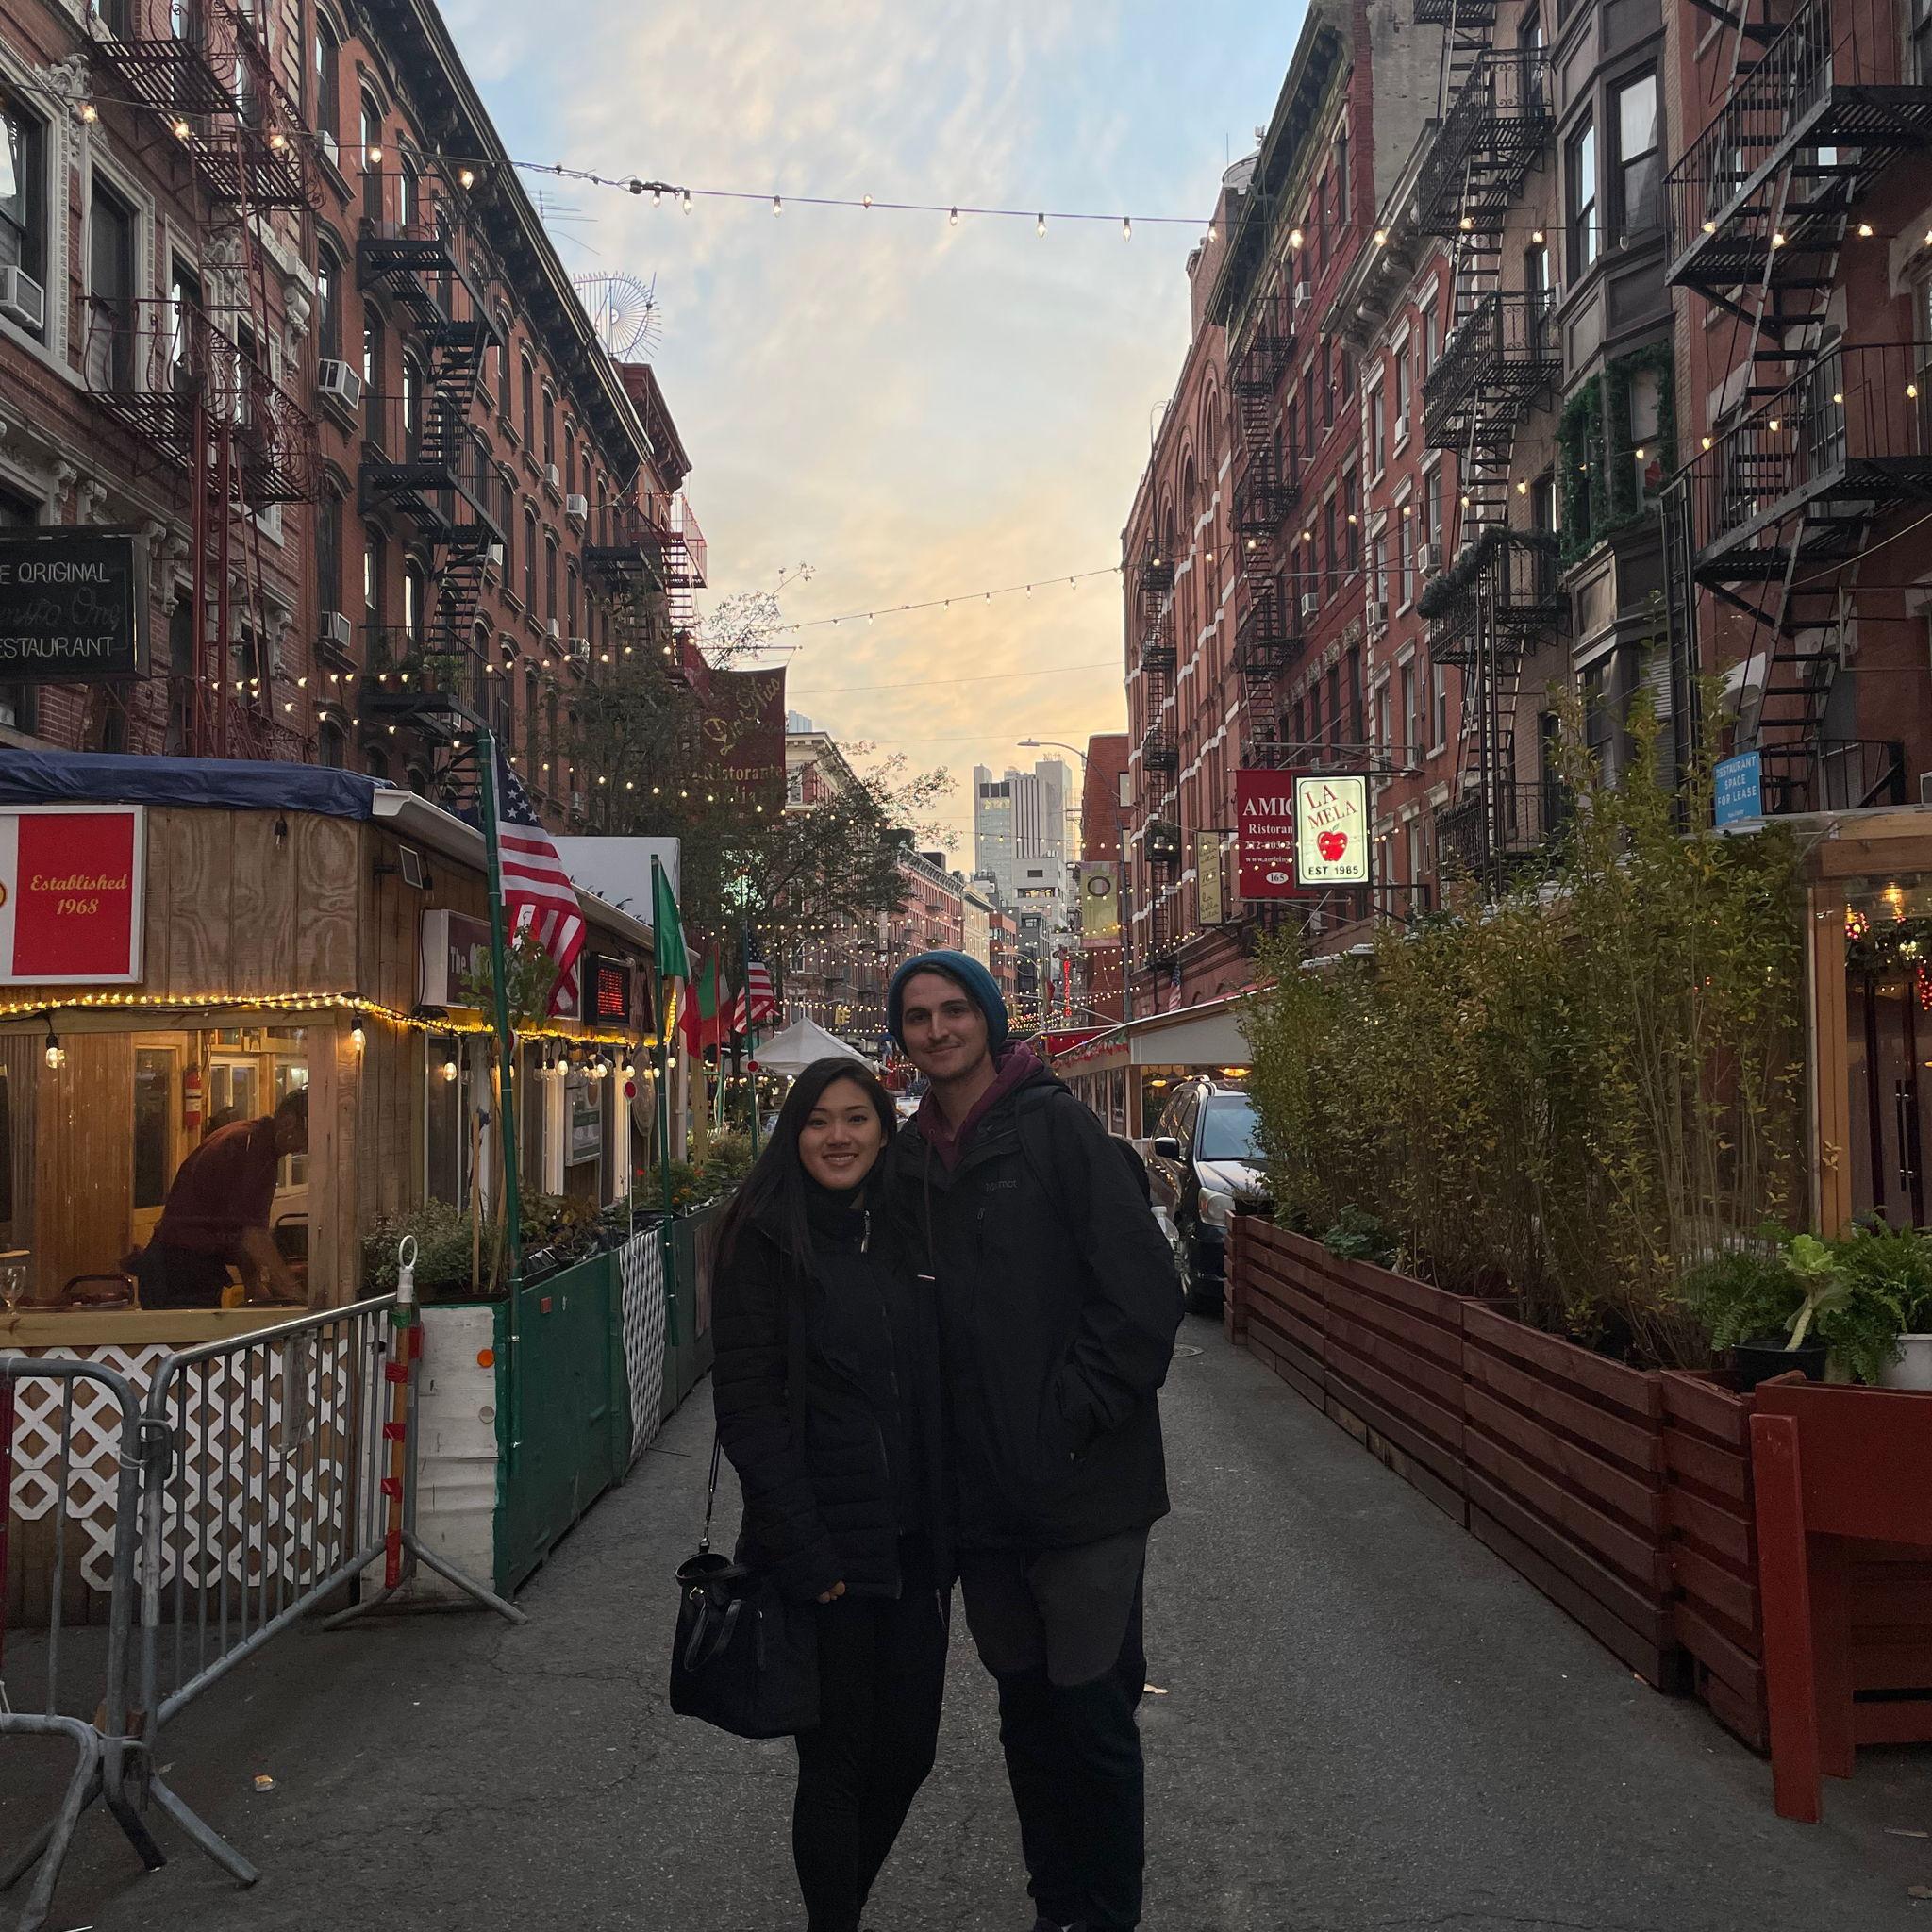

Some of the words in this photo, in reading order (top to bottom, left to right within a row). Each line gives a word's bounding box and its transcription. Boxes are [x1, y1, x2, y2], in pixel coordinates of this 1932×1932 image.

[18, 561, 112, 583] ORIGINAL
[0, 636, 114, 658] STAURANT
[1716, 756, 1757, 779] RESTAURANT
[1724, 774, 1746, 790] SPACE
[1306, 784, 1338, 810] LA
[1717, 793, 1731, 807] FOR
[1733, 785, 1757, 801] LEASE
[1307, 800, 1357, 829] MELA
[1269, 874, 1285, 882] 165
[1308, 866, 1328, 875] EST
[1335, 865, 1359, 874] 1985
[30, 874, 127, 891] Established
[57, 898, 99, 915] 1968
[450, 944, 467, 974] The
